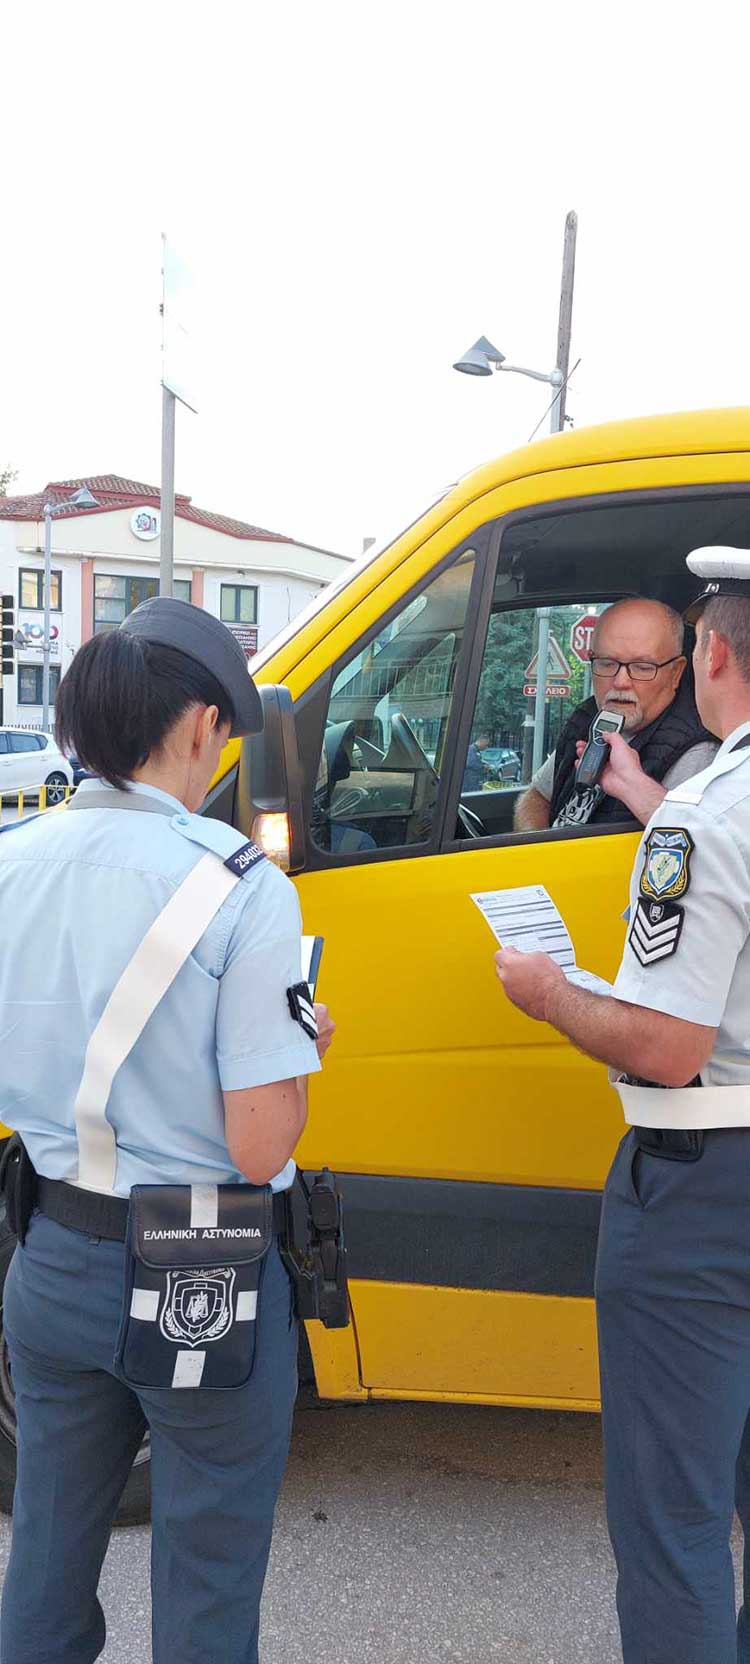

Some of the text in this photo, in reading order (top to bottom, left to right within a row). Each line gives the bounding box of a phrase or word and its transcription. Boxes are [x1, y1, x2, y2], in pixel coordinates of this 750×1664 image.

[574, 626, 594, 650] ST
[143, 1228, 262, 1240] ΕΛΛΗΝΙΚΗ ΑΣΤΥΝΟΜΙΑ
